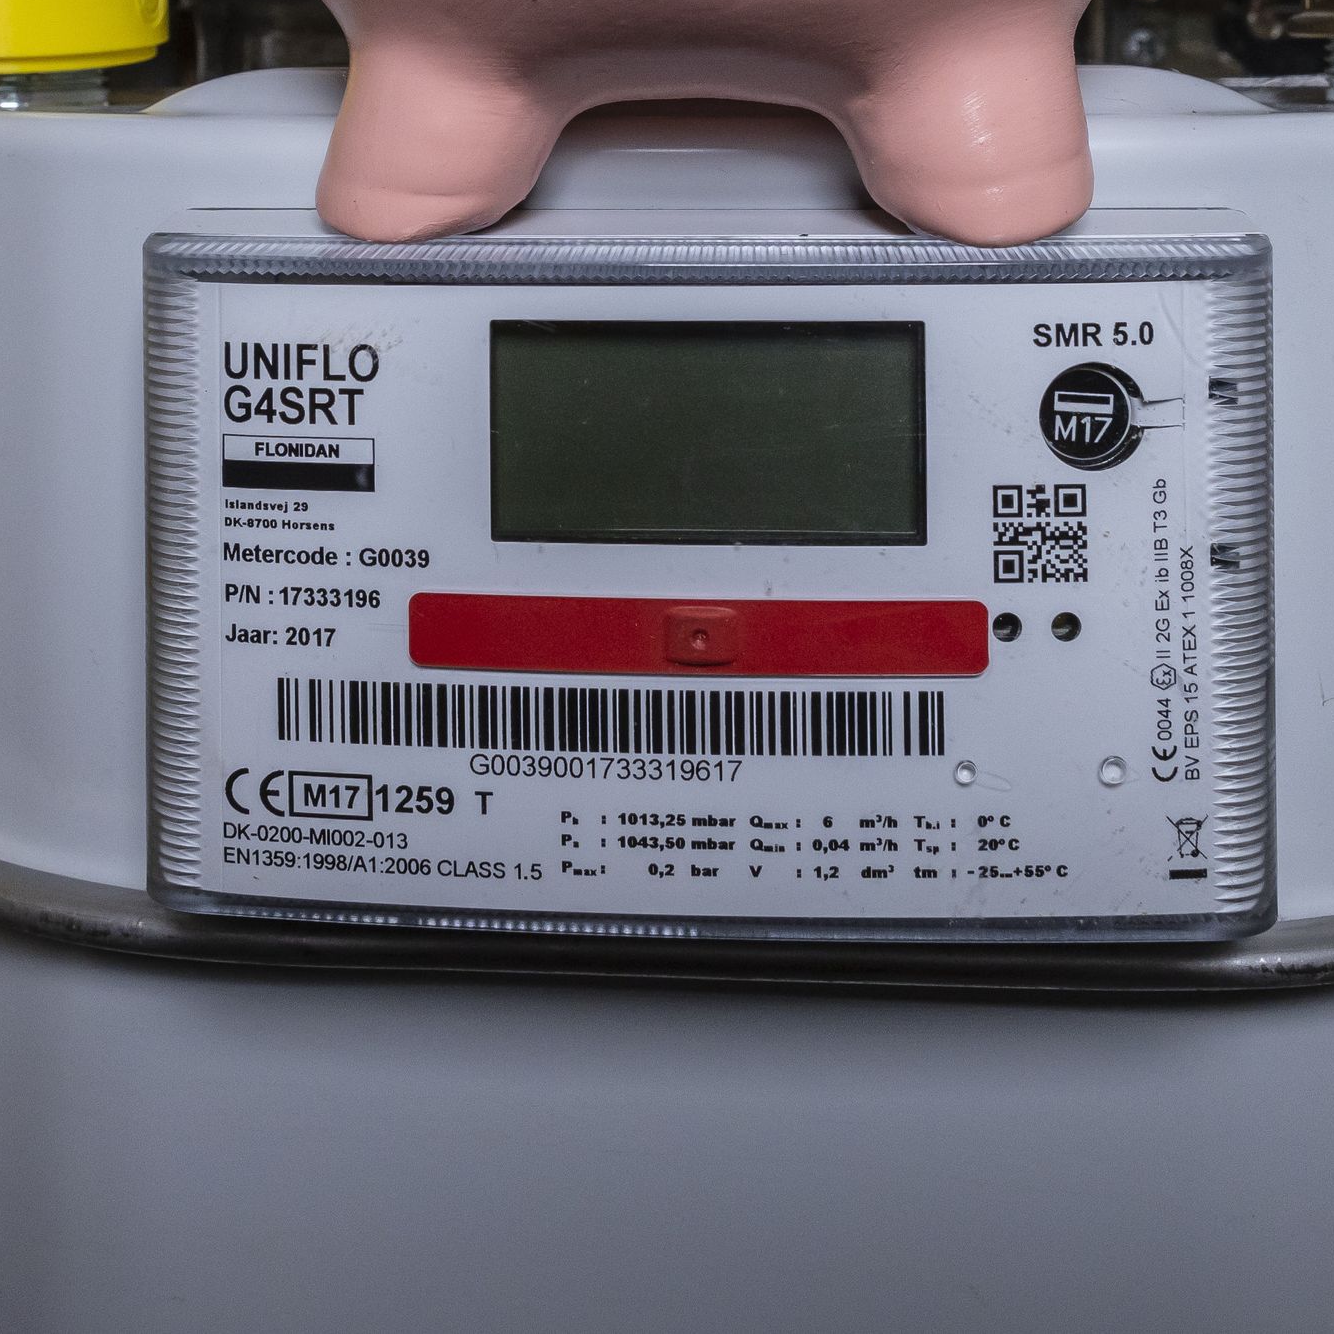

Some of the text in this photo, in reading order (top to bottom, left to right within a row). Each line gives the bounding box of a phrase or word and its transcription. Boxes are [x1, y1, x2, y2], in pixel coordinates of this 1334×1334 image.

[1033, 322, 1153, 347] SMR 5.0
[225, 342, 379, 382] UNIFLO
[224, 385, 364, 425] G4SRT
[1054, 415, 1113, 443] M17
[254, 442, 340, 458] FLONIDAN
[1153, 479, 1166, 504] Gb
[225, 499, 308, 513] Islandsvej 29
[225, 517, 334, 530] DK-8700 Horsens
[1153, 510, 1167, 533] T3
[224, 542, 338, 565] Metercode
[359, 548, 429, 568] G0039
[1154, 538, 1168, 561] IIB
[1155, 568, 1169, 582] ib
[1180, 546, 1195, 602] 1008X
[225, 584, 260, 604] P/N
[279, 587, 380, 608] 17333196
[1155, 590, 1169, 611] Ex
[225, 624, 336, 647] Jaar: 2017
[1156, 619, 1170, 642] 2G
[1182, 625, 1197, 676] ATEX
[1184, 683, 1198, 703] 15
[1157, 698, 1172, 740] 0044
[1184, 710, 1199, 748] EPS
[470, 753, 744, 782] G0039001733319617
[1185, 756, 1200, 780] BV
[304, 783, 360, 809] M17
[376, 784, 454, 815] 1259
[475, 791, 493, 815] T
[618, 813, 686, 828] 1013,25
[692, 815, 736, 827] mbar
[823, 816, 833, 828] 6
[223, 822, 408, 849] DK-0200-MI002-013
[618, 836, 685, 851] 1043,50
[691, 838, 735, 850] mbar
[812, 839, 850, 854] 0,04
[224, 847, 542, 880] EN1359:1998/A1:2006 CLASS 1.5
[648, 863, 674, 878] 0,2
[691, 865, 719, 877] bar
[749, 866, 762, 877] V
[814, 866, 839, 881] 1,2
[914, 866, 937, 878] tm
